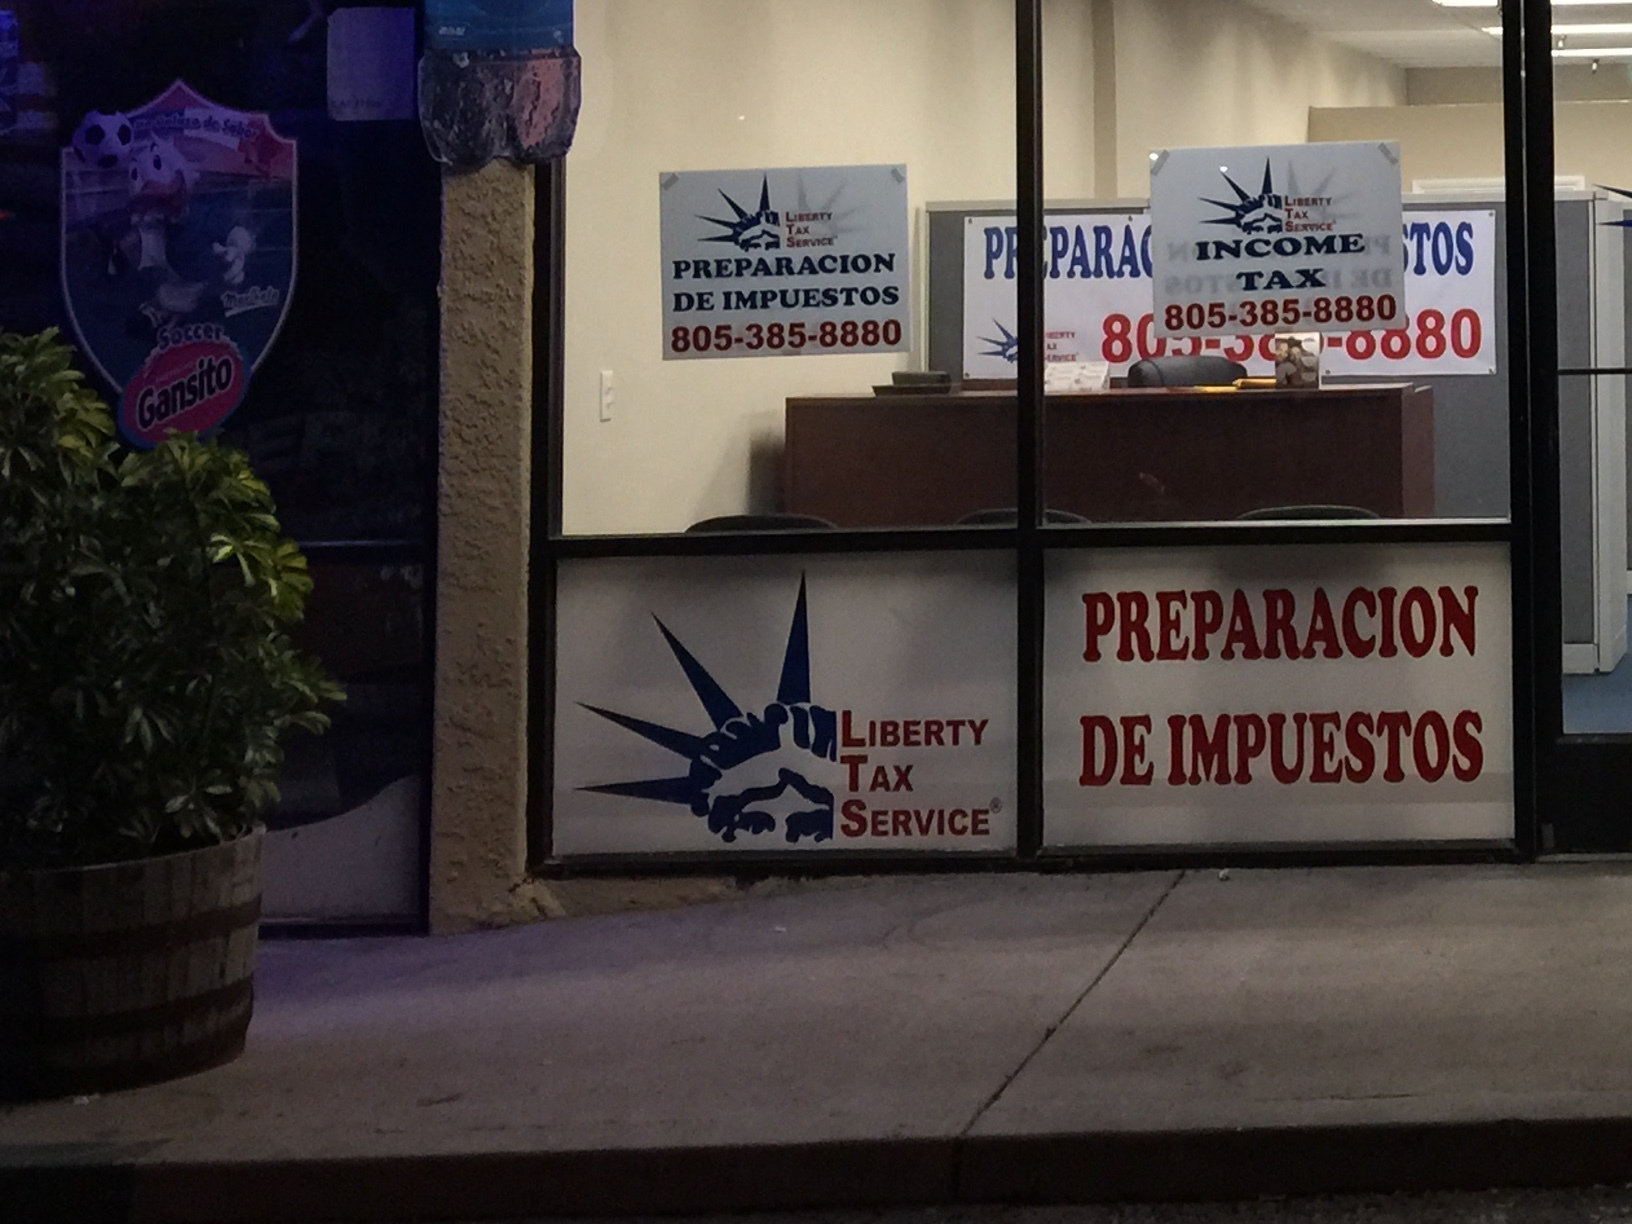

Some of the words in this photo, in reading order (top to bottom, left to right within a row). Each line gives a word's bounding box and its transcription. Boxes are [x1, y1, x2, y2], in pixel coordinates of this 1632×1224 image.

[1285, 195, 1333, 207] LIBERTY
[1285, 208, 1309, 220] TAX
[785, 211, 833, 223] LIBERTY
[785, 224, 810, 236] TAX
[1285, 221, 1333, 232] SERVICE
[786, 236, 834, 249] SERVICE
[1196, 233, 1366, 261] INCOME
[672, 253, 895, 280] PREPARACION
[1236, 268, 1327, 291] TAX
[672, 292, 714, 313] DE
[722, 286, 900, 311] IMPUESTOS
[1164, 294, 1397, 331] 805-385-8880
[157, 322, 224, 350] Soccer
[671, 319, 902, 353] 805-385-8880
[1045, 354, 1077, 363] ERVICE
[138, 356, 233, 429] Gansito
[1081, 585, 1480, 663] PREPARACION
[840, 709, 989, 748] LIBERTY
[1079, 713, 1155, 787] DE
[1167, 710, 1484, 786] IMPUESTOS
[840, 755, 914, 793] TAX
[840, 799, 990, 839] SERVICE
